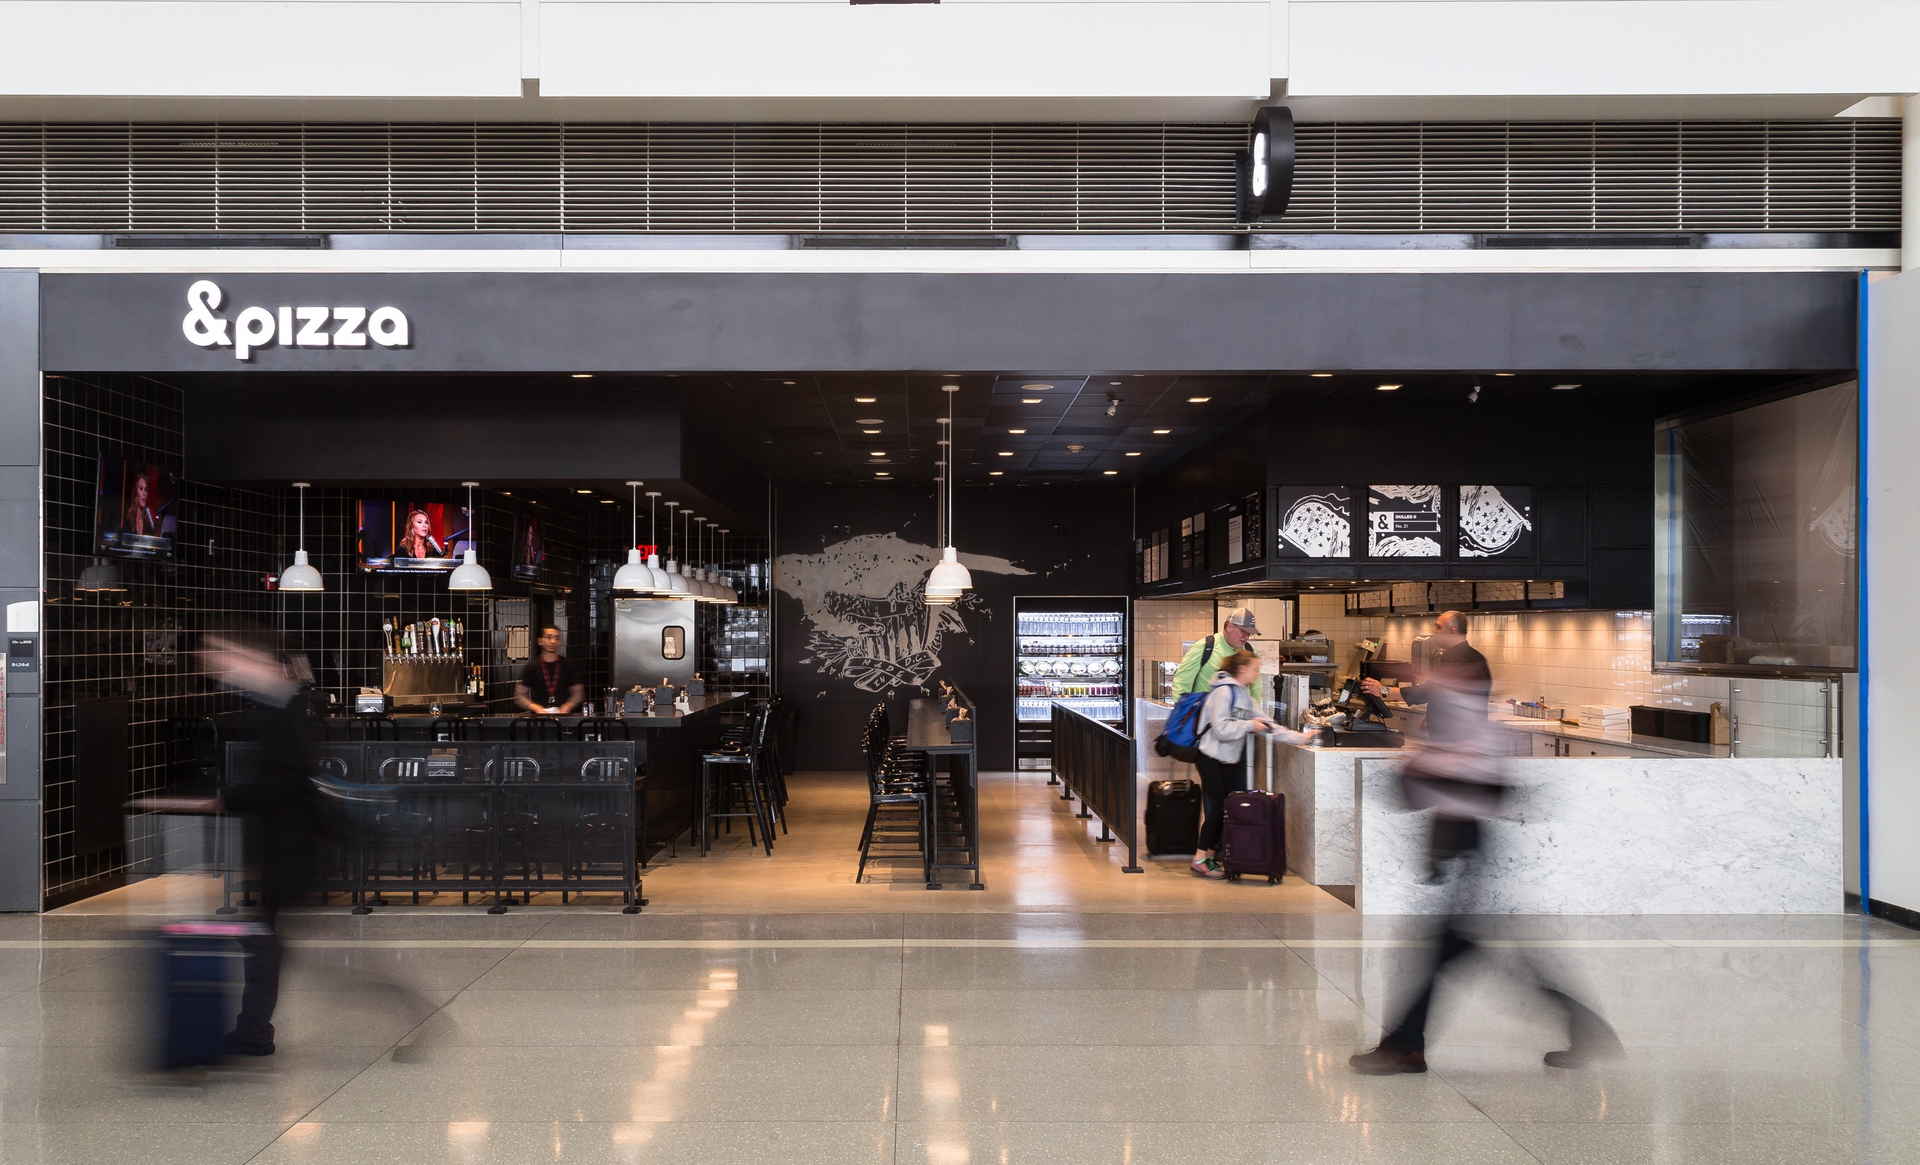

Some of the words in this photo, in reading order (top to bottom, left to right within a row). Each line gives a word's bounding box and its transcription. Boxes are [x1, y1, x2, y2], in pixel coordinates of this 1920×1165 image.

[182, 280, 409, 360] &pizza
[1378, 514, 1389, 530] &
[638, 545, 658, 560] EXIT
[905, 654, 927, 667] D.C.
[862, 659, 905, 678] MADE
[873, 676, 886, 687] IN
